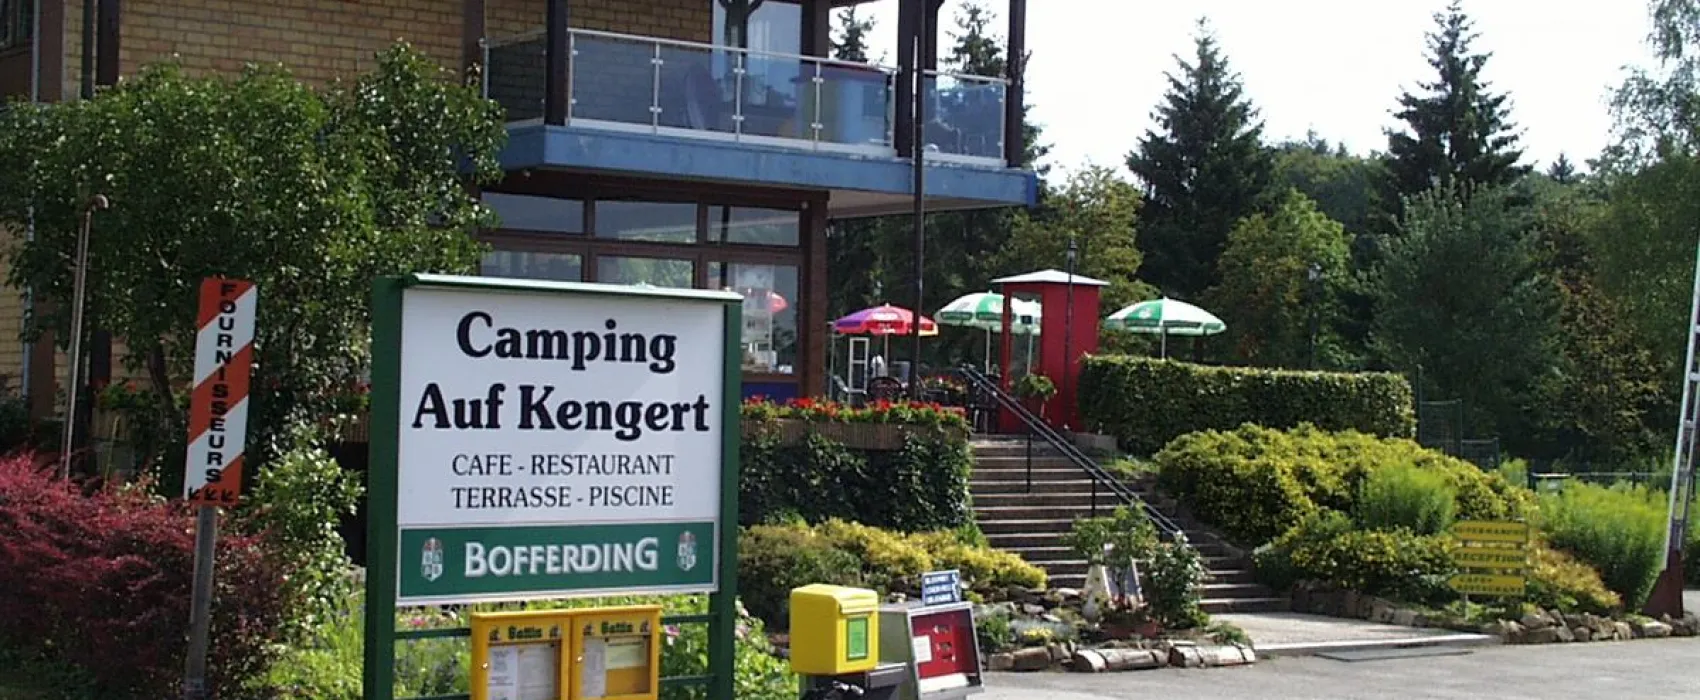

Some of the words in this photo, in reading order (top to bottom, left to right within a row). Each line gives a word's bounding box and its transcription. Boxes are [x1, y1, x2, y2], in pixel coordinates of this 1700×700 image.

[456, 311, 677, 373] Camping
[205, 283, 237, 483] FOURNISSEURS
[412, 383, 505, 429] Auf
[518, 384, 710, 441] Kengert
[452, 454, 512, 475] CAFE
[531, 454, 674, 475] RESTAURANT
[451, 486, 571, 508] TERRASSE
[589, 486, 673, 507] PISCINE
[464, 537, 659, 577] BOFFERDING
